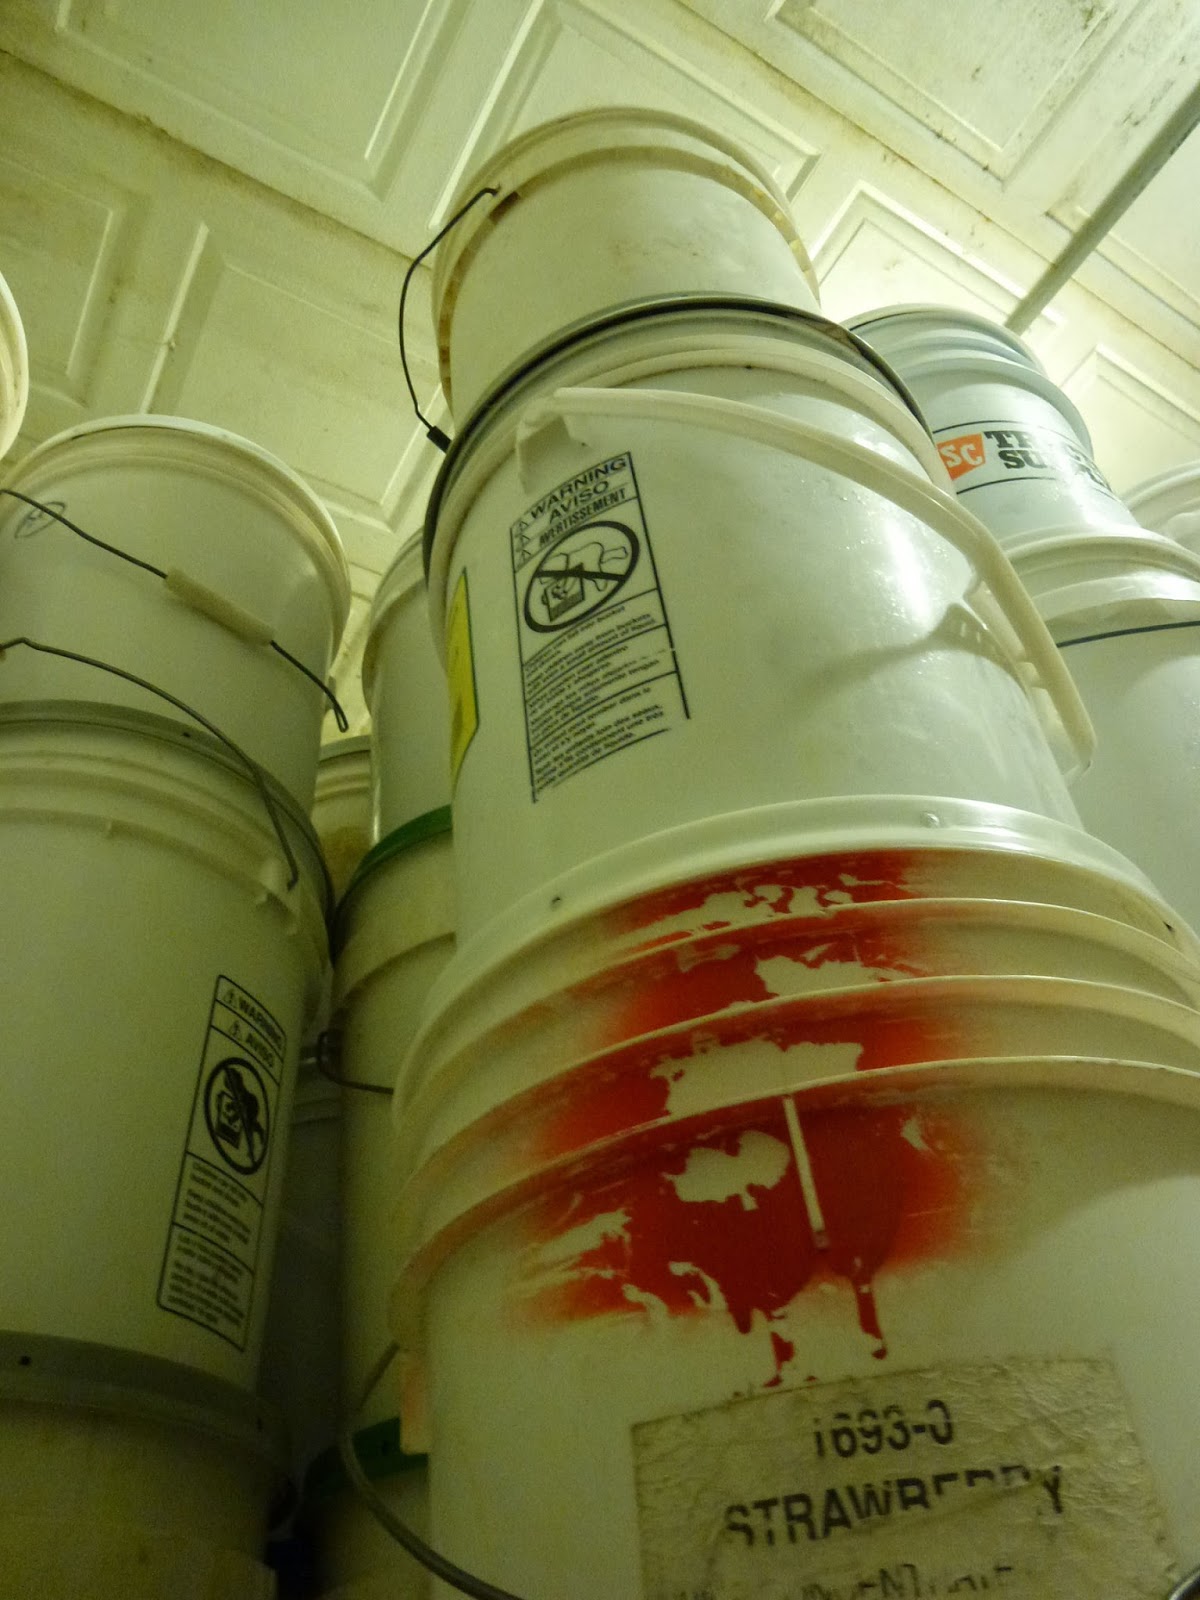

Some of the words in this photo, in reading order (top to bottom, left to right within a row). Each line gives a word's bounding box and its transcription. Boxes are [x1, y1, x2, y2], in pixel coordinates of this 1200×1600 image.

[530, 458, 626, 519] WARNING
[539, 487, 626, 545] AVERTISSEMENT
[549, 480, 609, 525] AVISO
